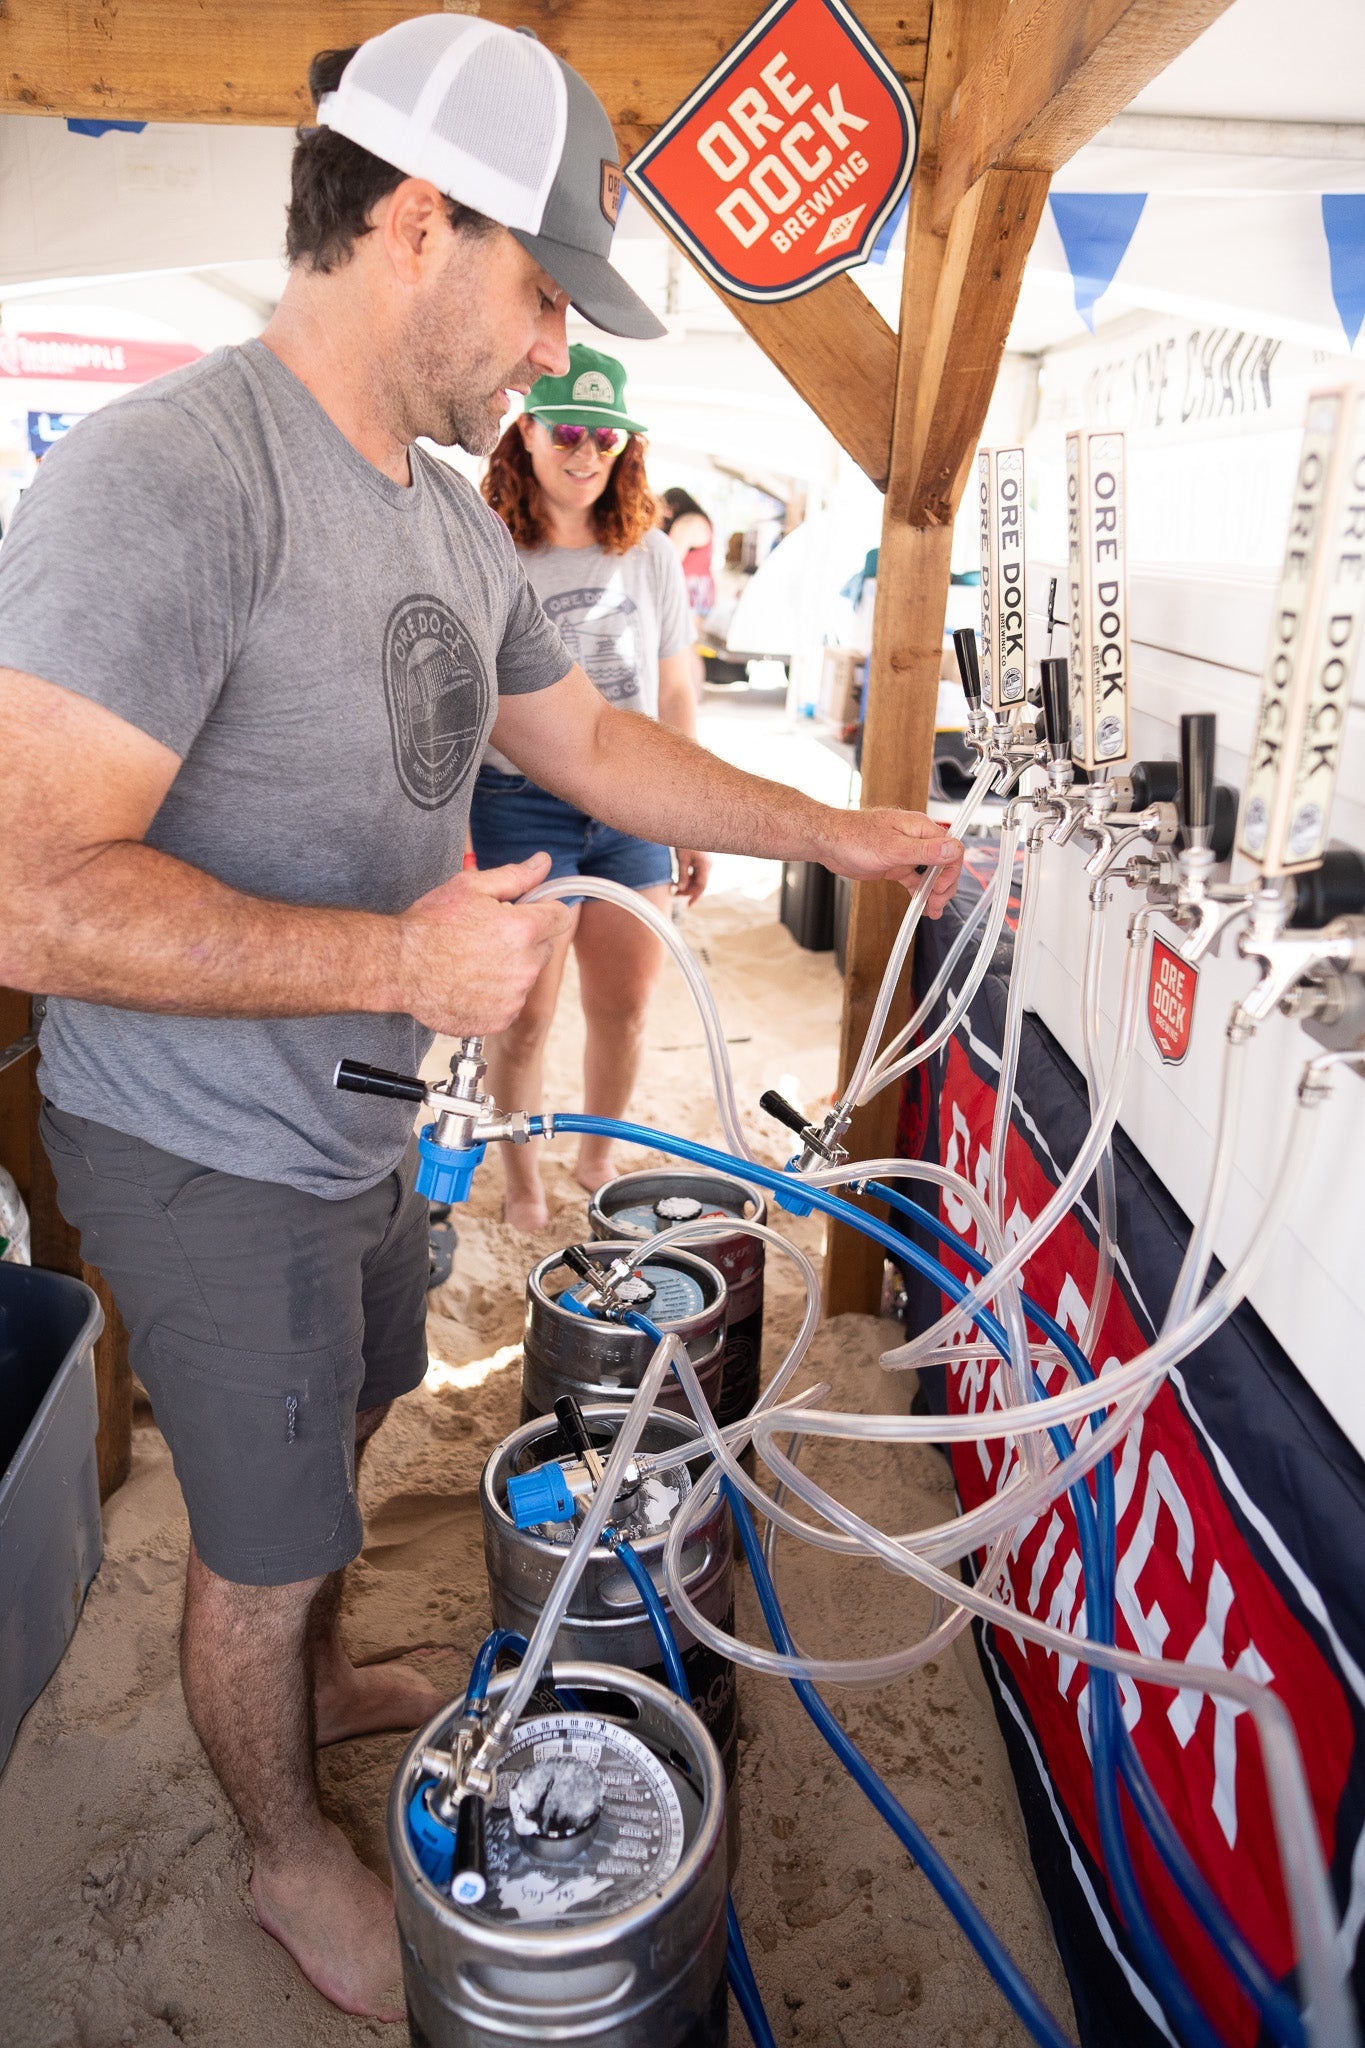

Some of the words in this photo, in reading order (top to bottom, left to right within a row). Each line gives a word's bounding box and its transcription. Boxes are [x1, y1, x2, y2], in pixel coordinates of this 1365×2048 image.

[696, 50, 814, 183] ORE
[714, 82, 870, 250] DOCK
[769, 150, 870, 255] BREWING
[1000, 478, 1020, 551] ORE
[1094, 471, 1118, 563] ORE
[394, 616, 418, 662] ORE
[418, 612, 465, 656] DOCK
[1003, 562, 1024, 656] DOCK
[1098, 580, 1124, 700] DOCK
[1000, 655, 1007, 667] CO
[1256, 609, 1298, 773] DOCK
[1308, 613, 1353, 780] DOCK
[1152, 980, 1186, 1034] DOCK
[1160, 957, 1186, 1000] ORE
